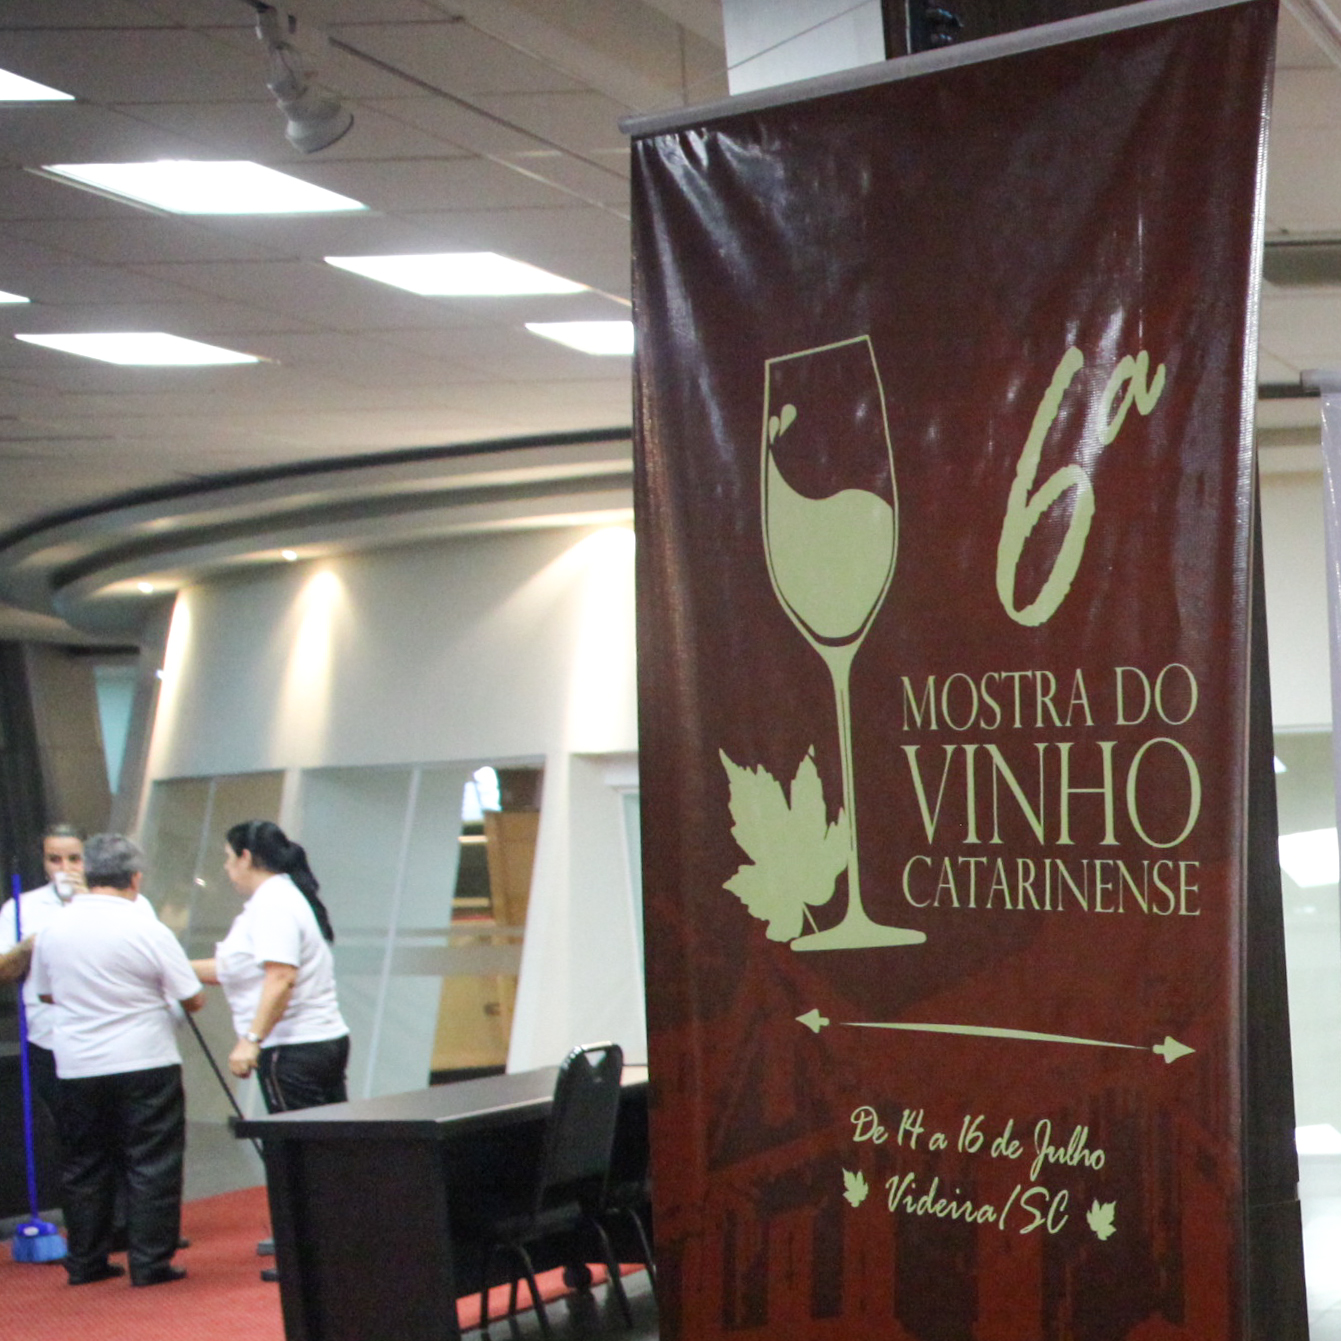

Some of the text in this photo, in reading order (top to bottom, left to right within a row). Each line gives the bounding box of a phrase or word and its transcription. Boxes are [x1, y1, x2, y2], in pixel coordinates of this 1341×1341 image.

[901, 663, 1198, 731] MOSTRA DO
[902, 737, 1202, 848] VINHO
[902, 855, 1201, 915] CATARINENSE
[851, 1106, 1105, 1181] De 14 a 16 de Julho
[885, 1172, 1070, 1235] Videira/SC
